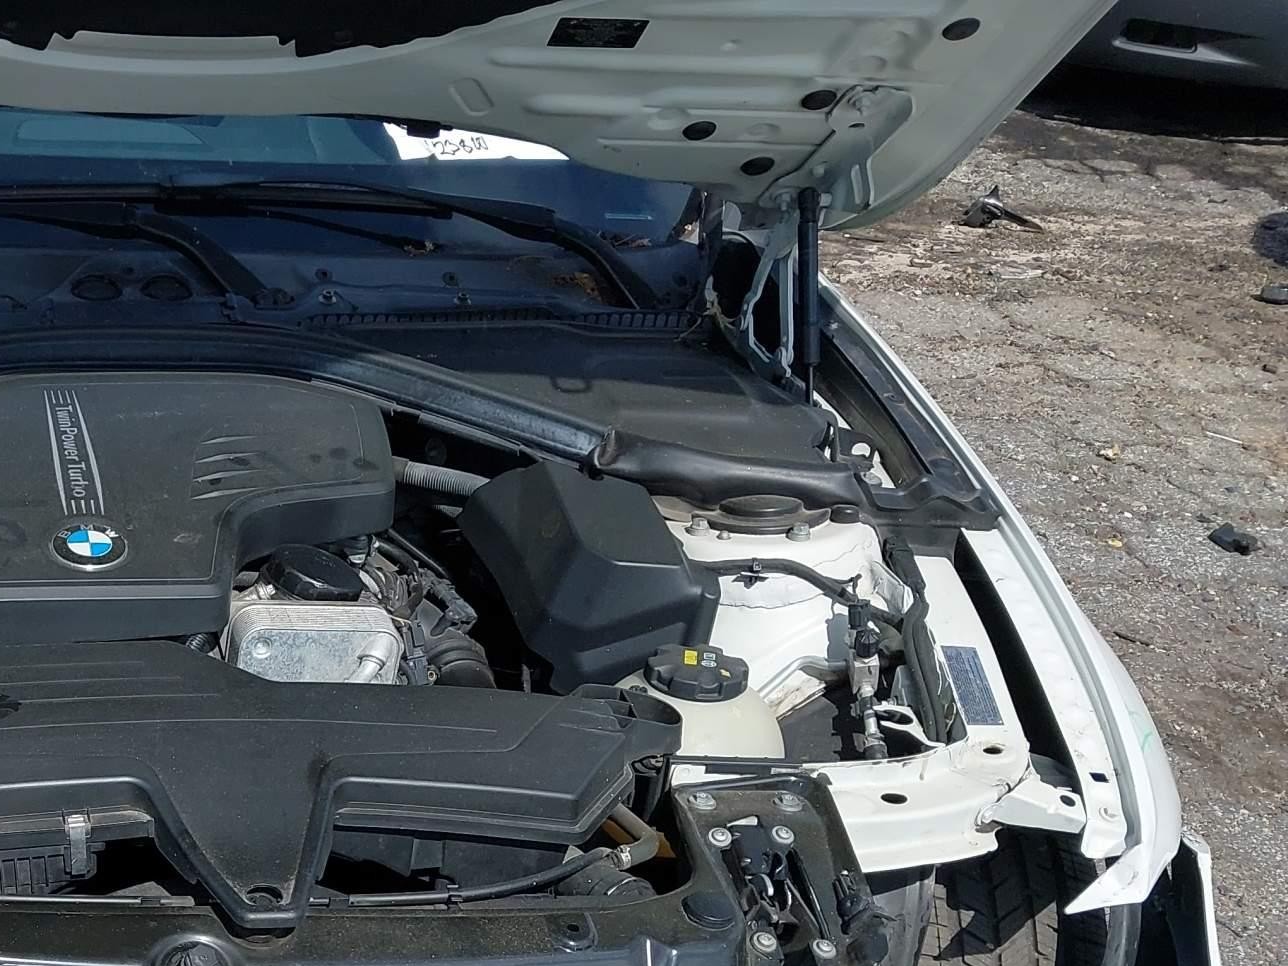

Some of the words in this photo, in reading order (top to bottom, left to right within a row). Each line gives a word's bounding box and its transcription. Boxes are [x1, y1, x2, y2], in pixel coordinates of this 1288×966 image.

[55, 404, 79, 462] TwinPower
[67, 461, 89, 498] Turbo
[58, 523, 120, 539] BMW
